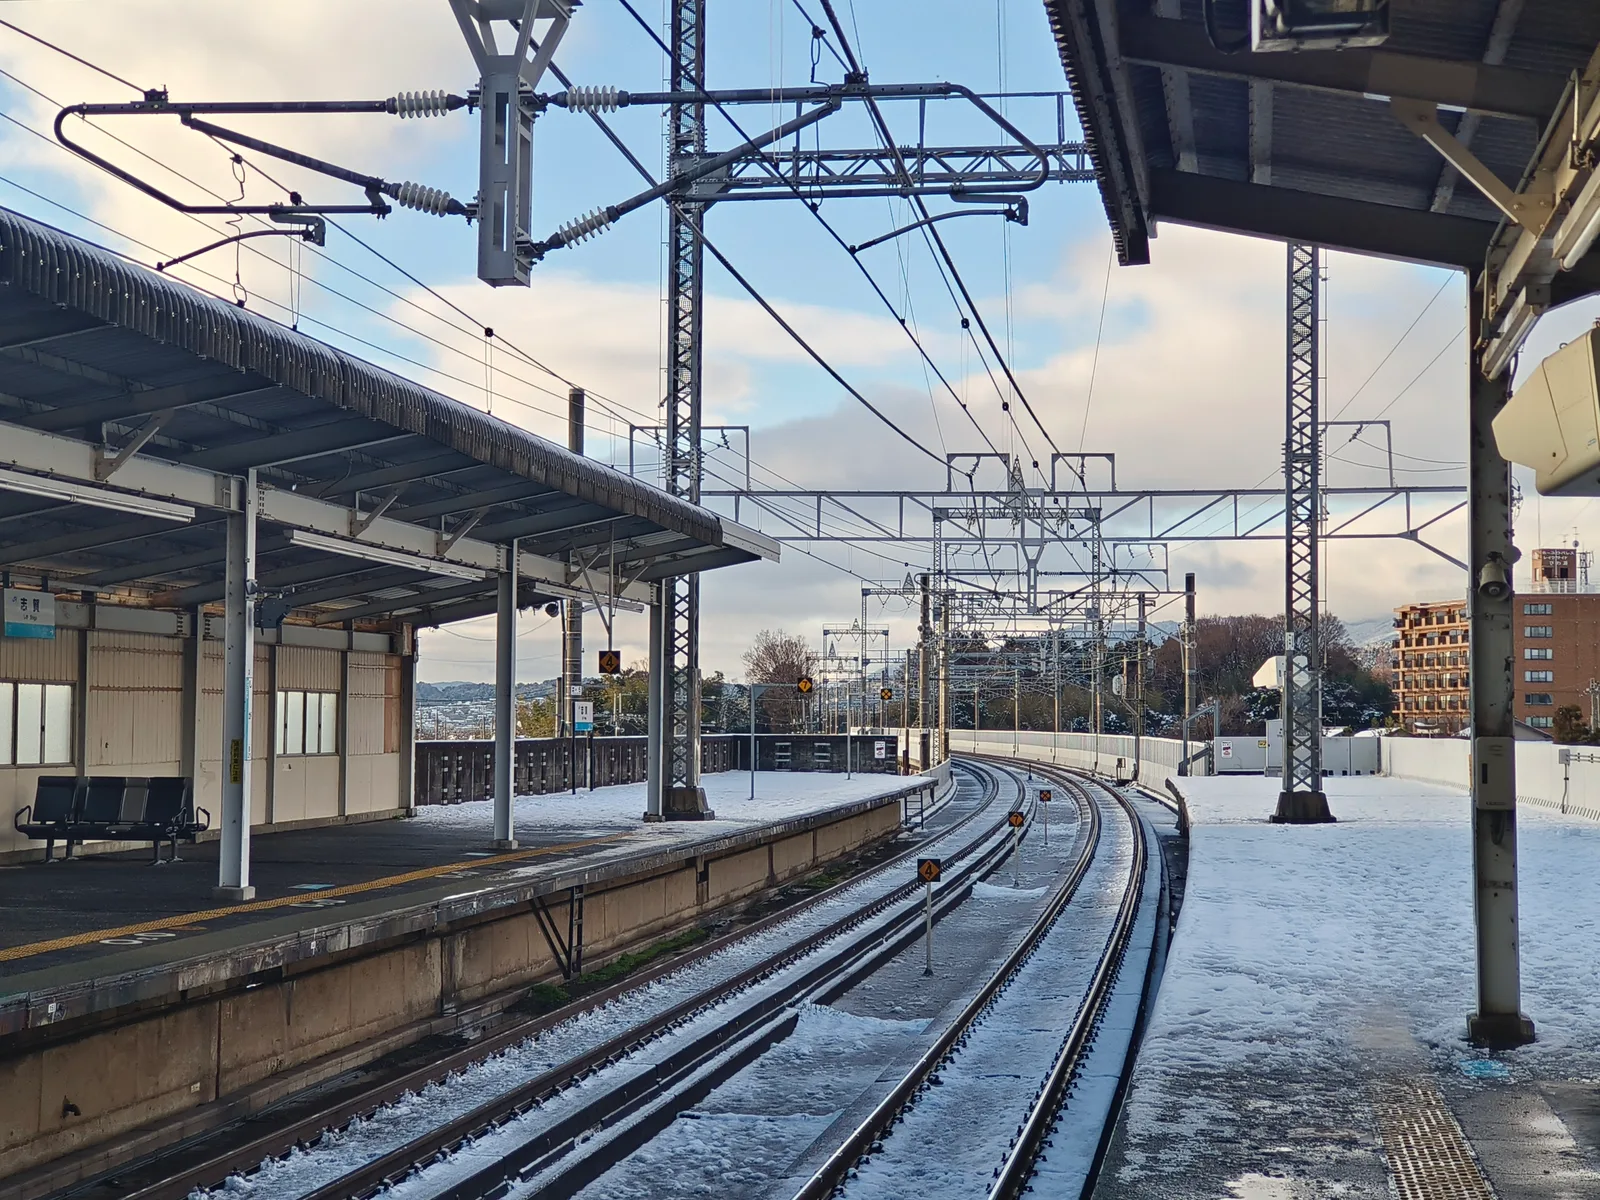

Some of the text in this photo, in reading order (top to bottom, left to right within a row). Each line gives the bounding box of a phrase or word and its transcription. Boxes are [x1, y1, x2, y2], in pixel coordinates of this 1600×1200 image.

[20, 597, 40, 613] 志賀
[606, 656, 613, 668] 4
[924, 861, 933, 878] 4
